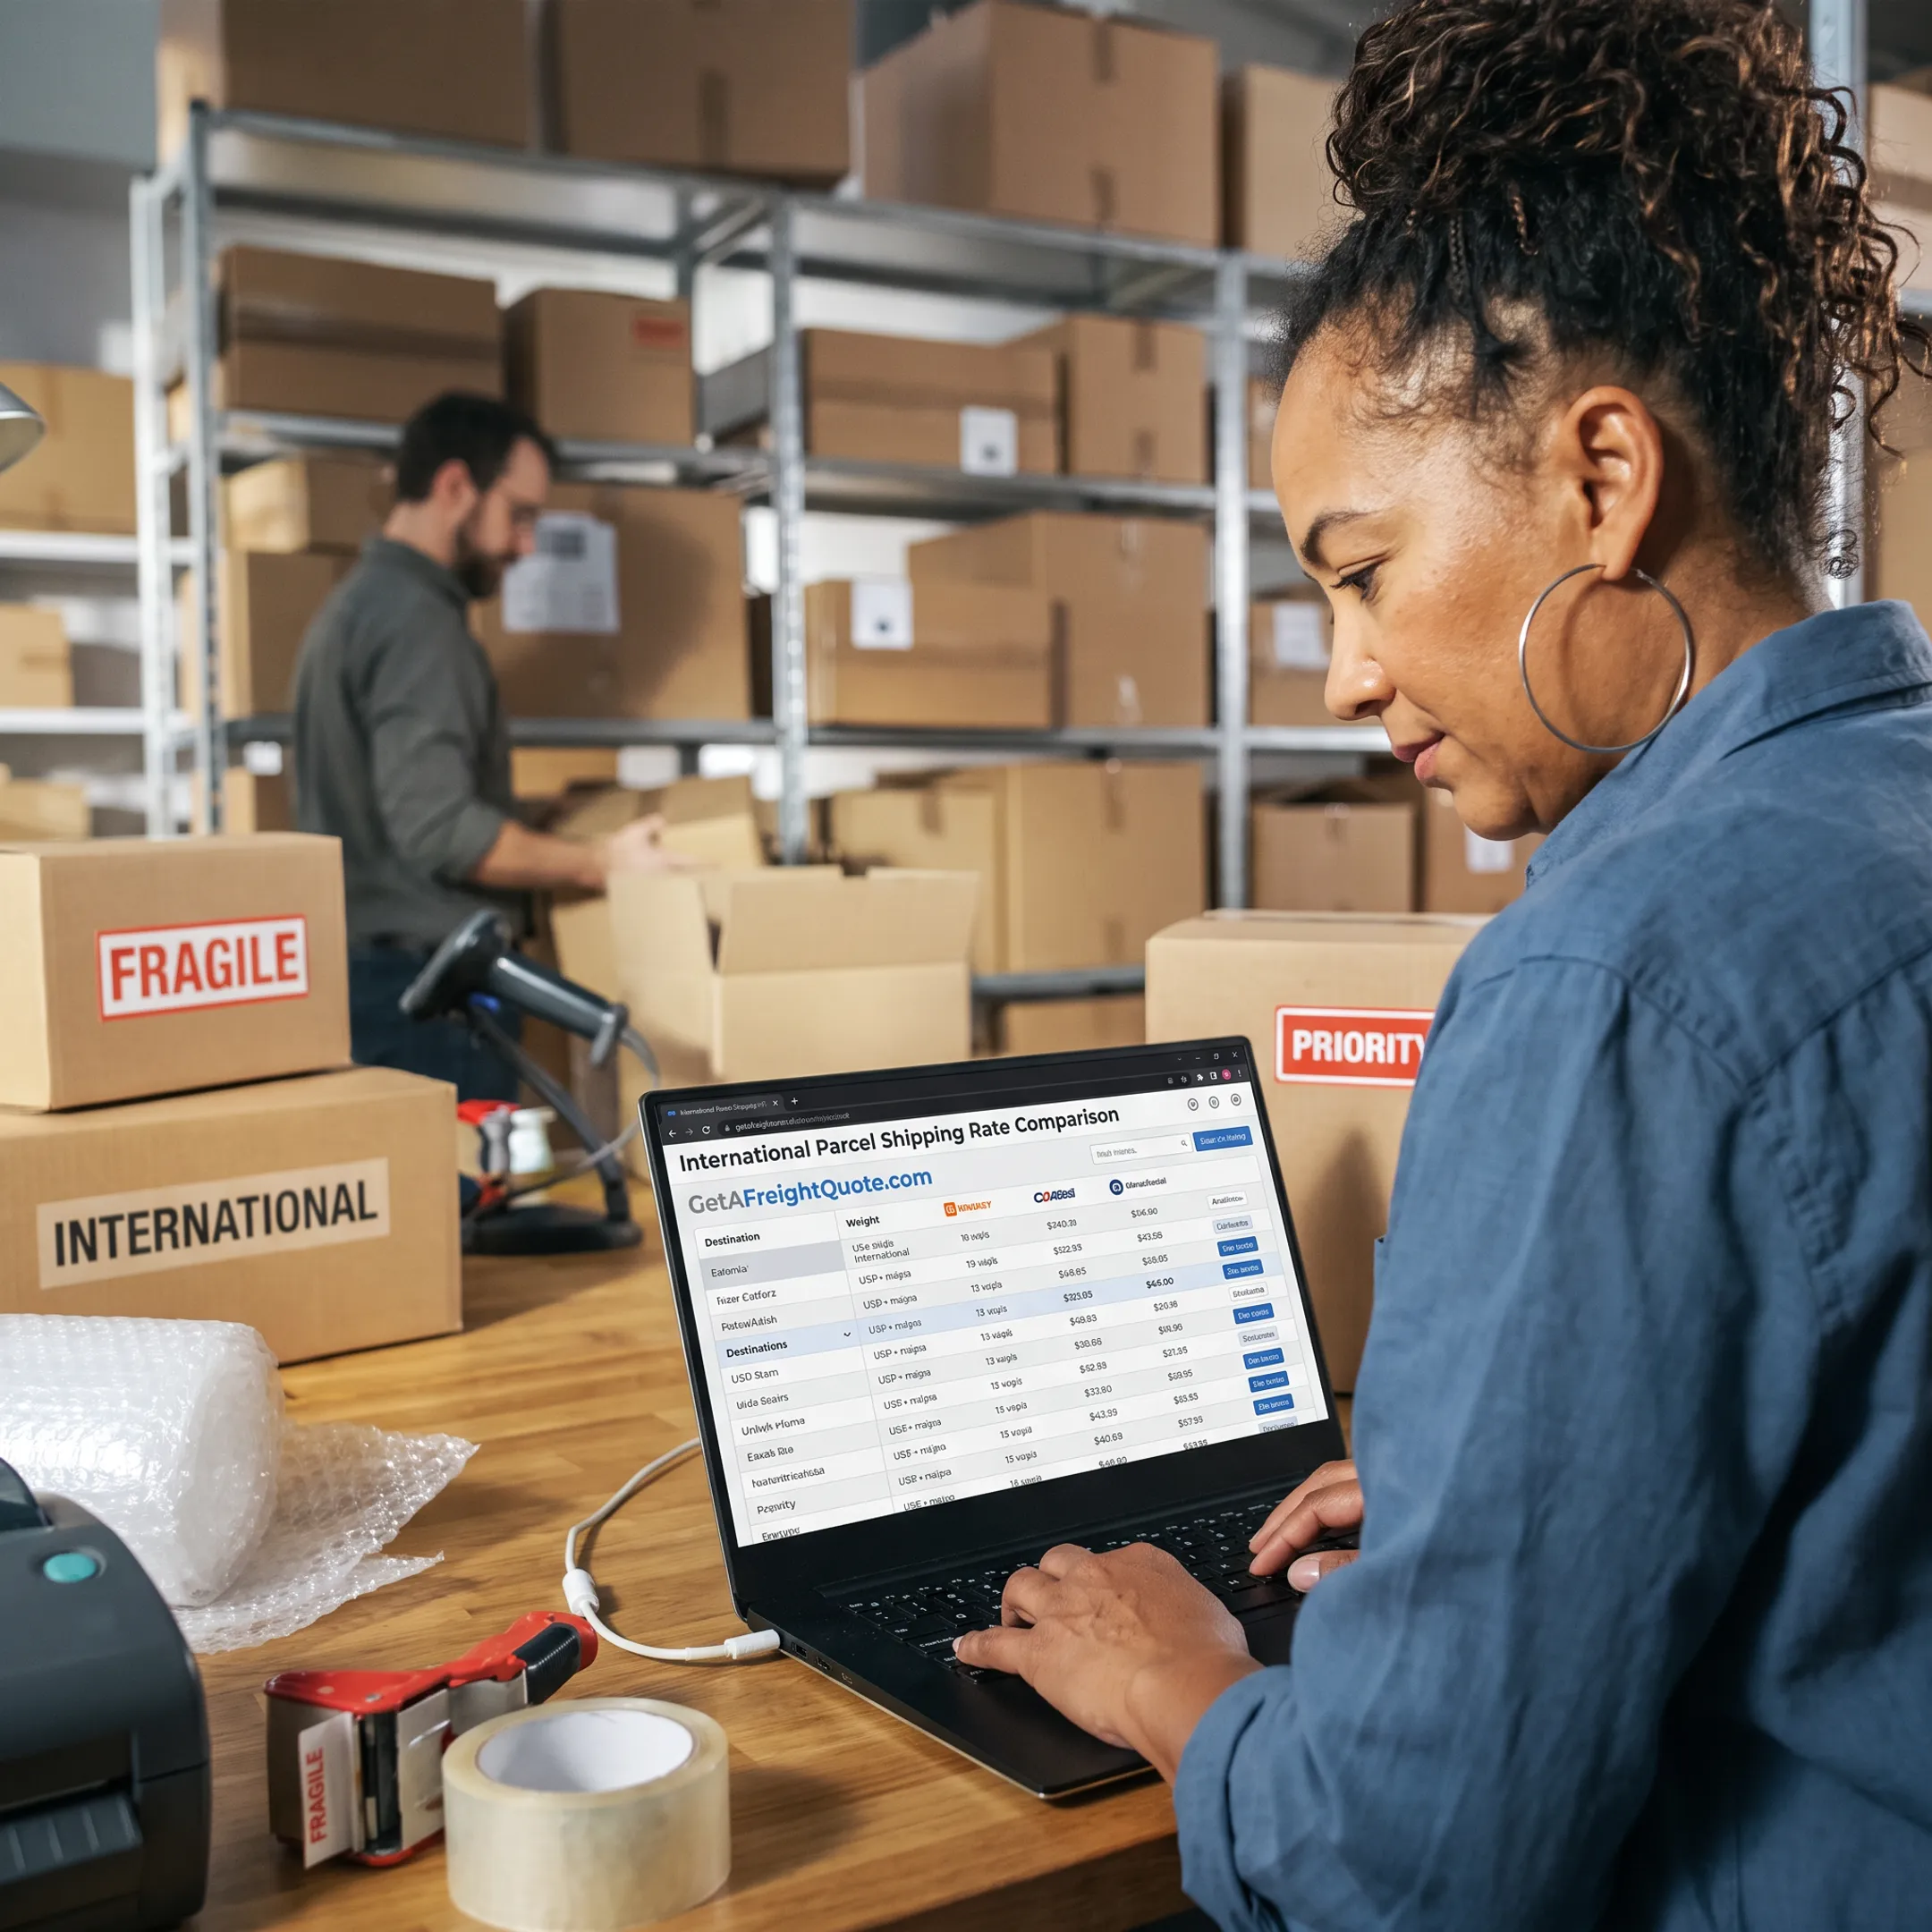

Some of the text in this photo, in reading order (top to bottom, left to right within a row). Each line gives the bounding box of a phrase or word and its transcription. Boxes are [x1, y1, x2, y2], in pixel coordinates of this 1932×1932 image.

[110, 931, 299, 1002] FRAGILE
[679, 1108, 1120, 1172] International Parcel Shipping Rate Comparison
[688, 1170, 933, 1214] GetAFreightQuote.com
[55, 1180, 377, 1267] INTERNATIONAL
[705, 1233, 760, 1247] Destination
[846, 1216, 879, 1227] Weight
[726, 1342, 787, 1357] Destinations
[732, 1373, 751, 1384] USD
[306, 1747, 326, 1843] FRAGILE
